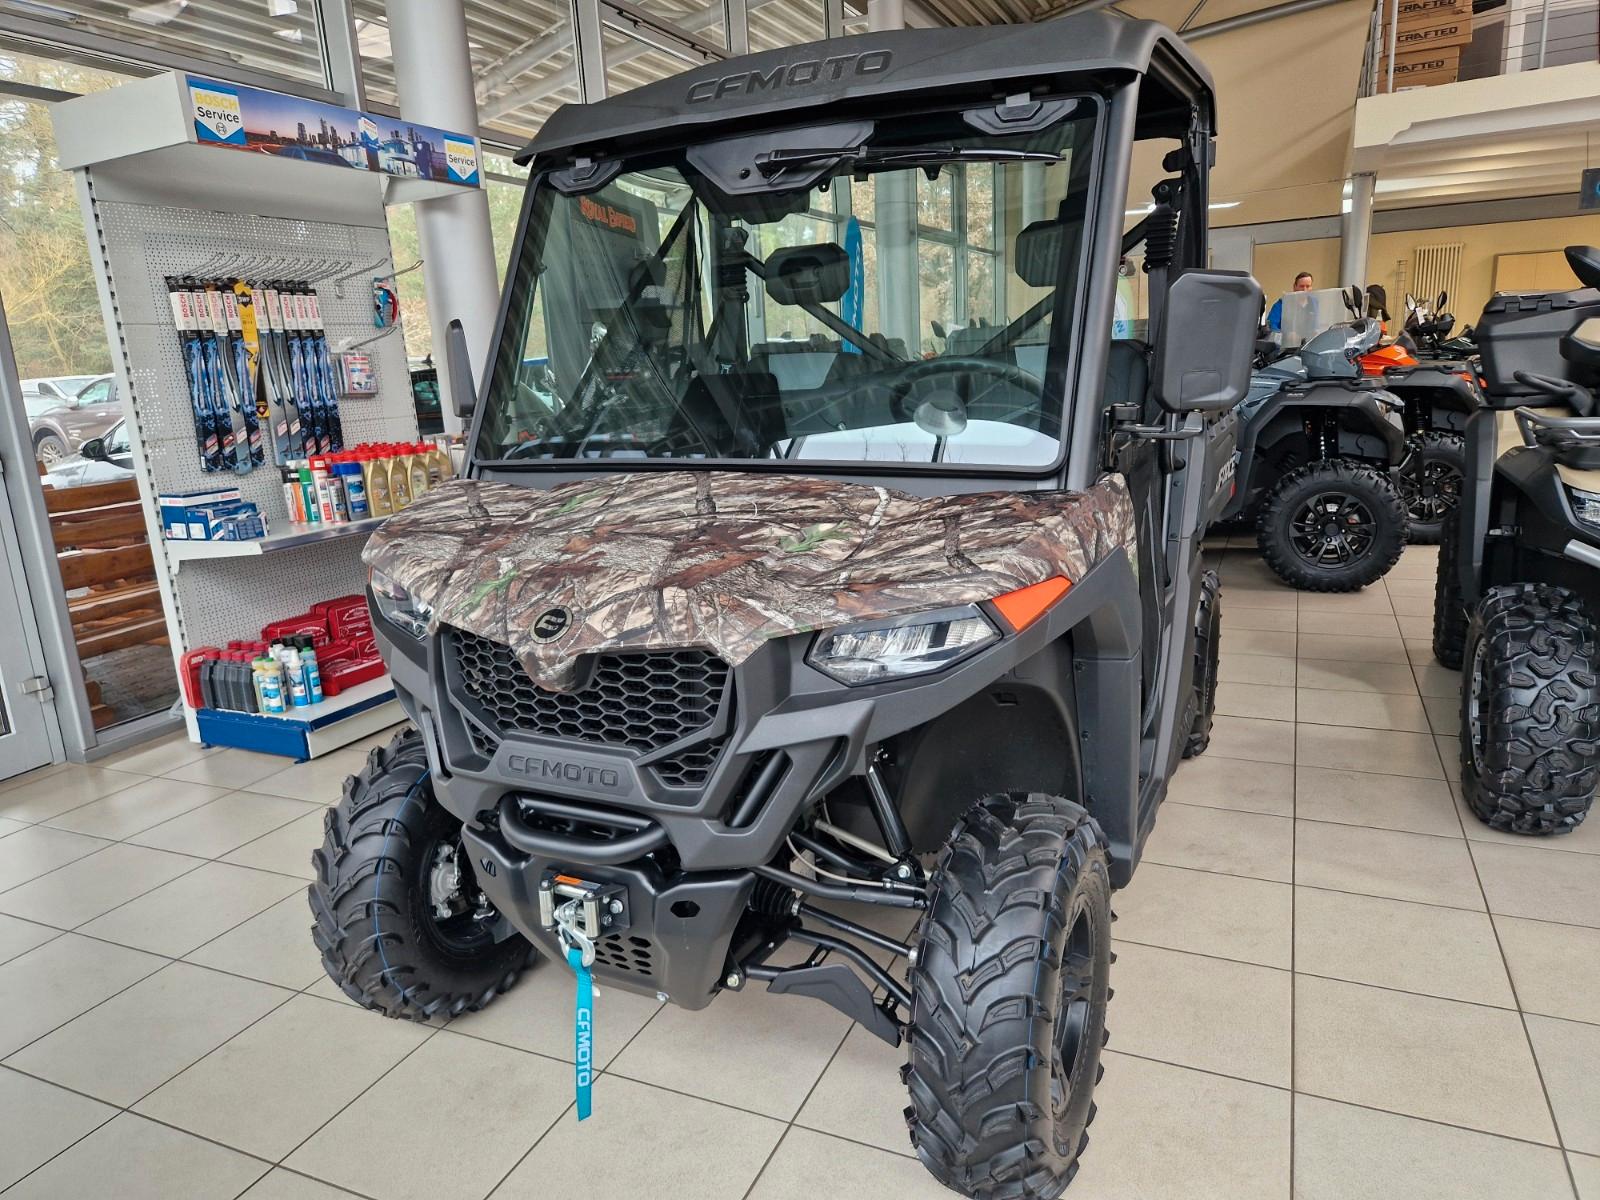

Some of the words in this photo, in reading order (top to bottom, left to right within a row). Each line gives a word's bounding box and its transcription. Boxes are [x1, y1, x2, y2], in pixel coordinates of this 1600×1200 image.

[1397, 26, 1458, 42] CRAFTED
[686, 50, 892, 104] CFMOTO
[194, 91, 238, 110] BOSCH
[197, 106, 239, 124] Service
[448, 154, 475, 167] Service
[180, 293, 189, 318] BOSCH
[196, 294, 205, 318] BOSCH
[225, 295, 234, 318] BOSCH
[508, 754, 619, 787] CFMOTO
[577, 1007, 591, 1088] CFMOTO
